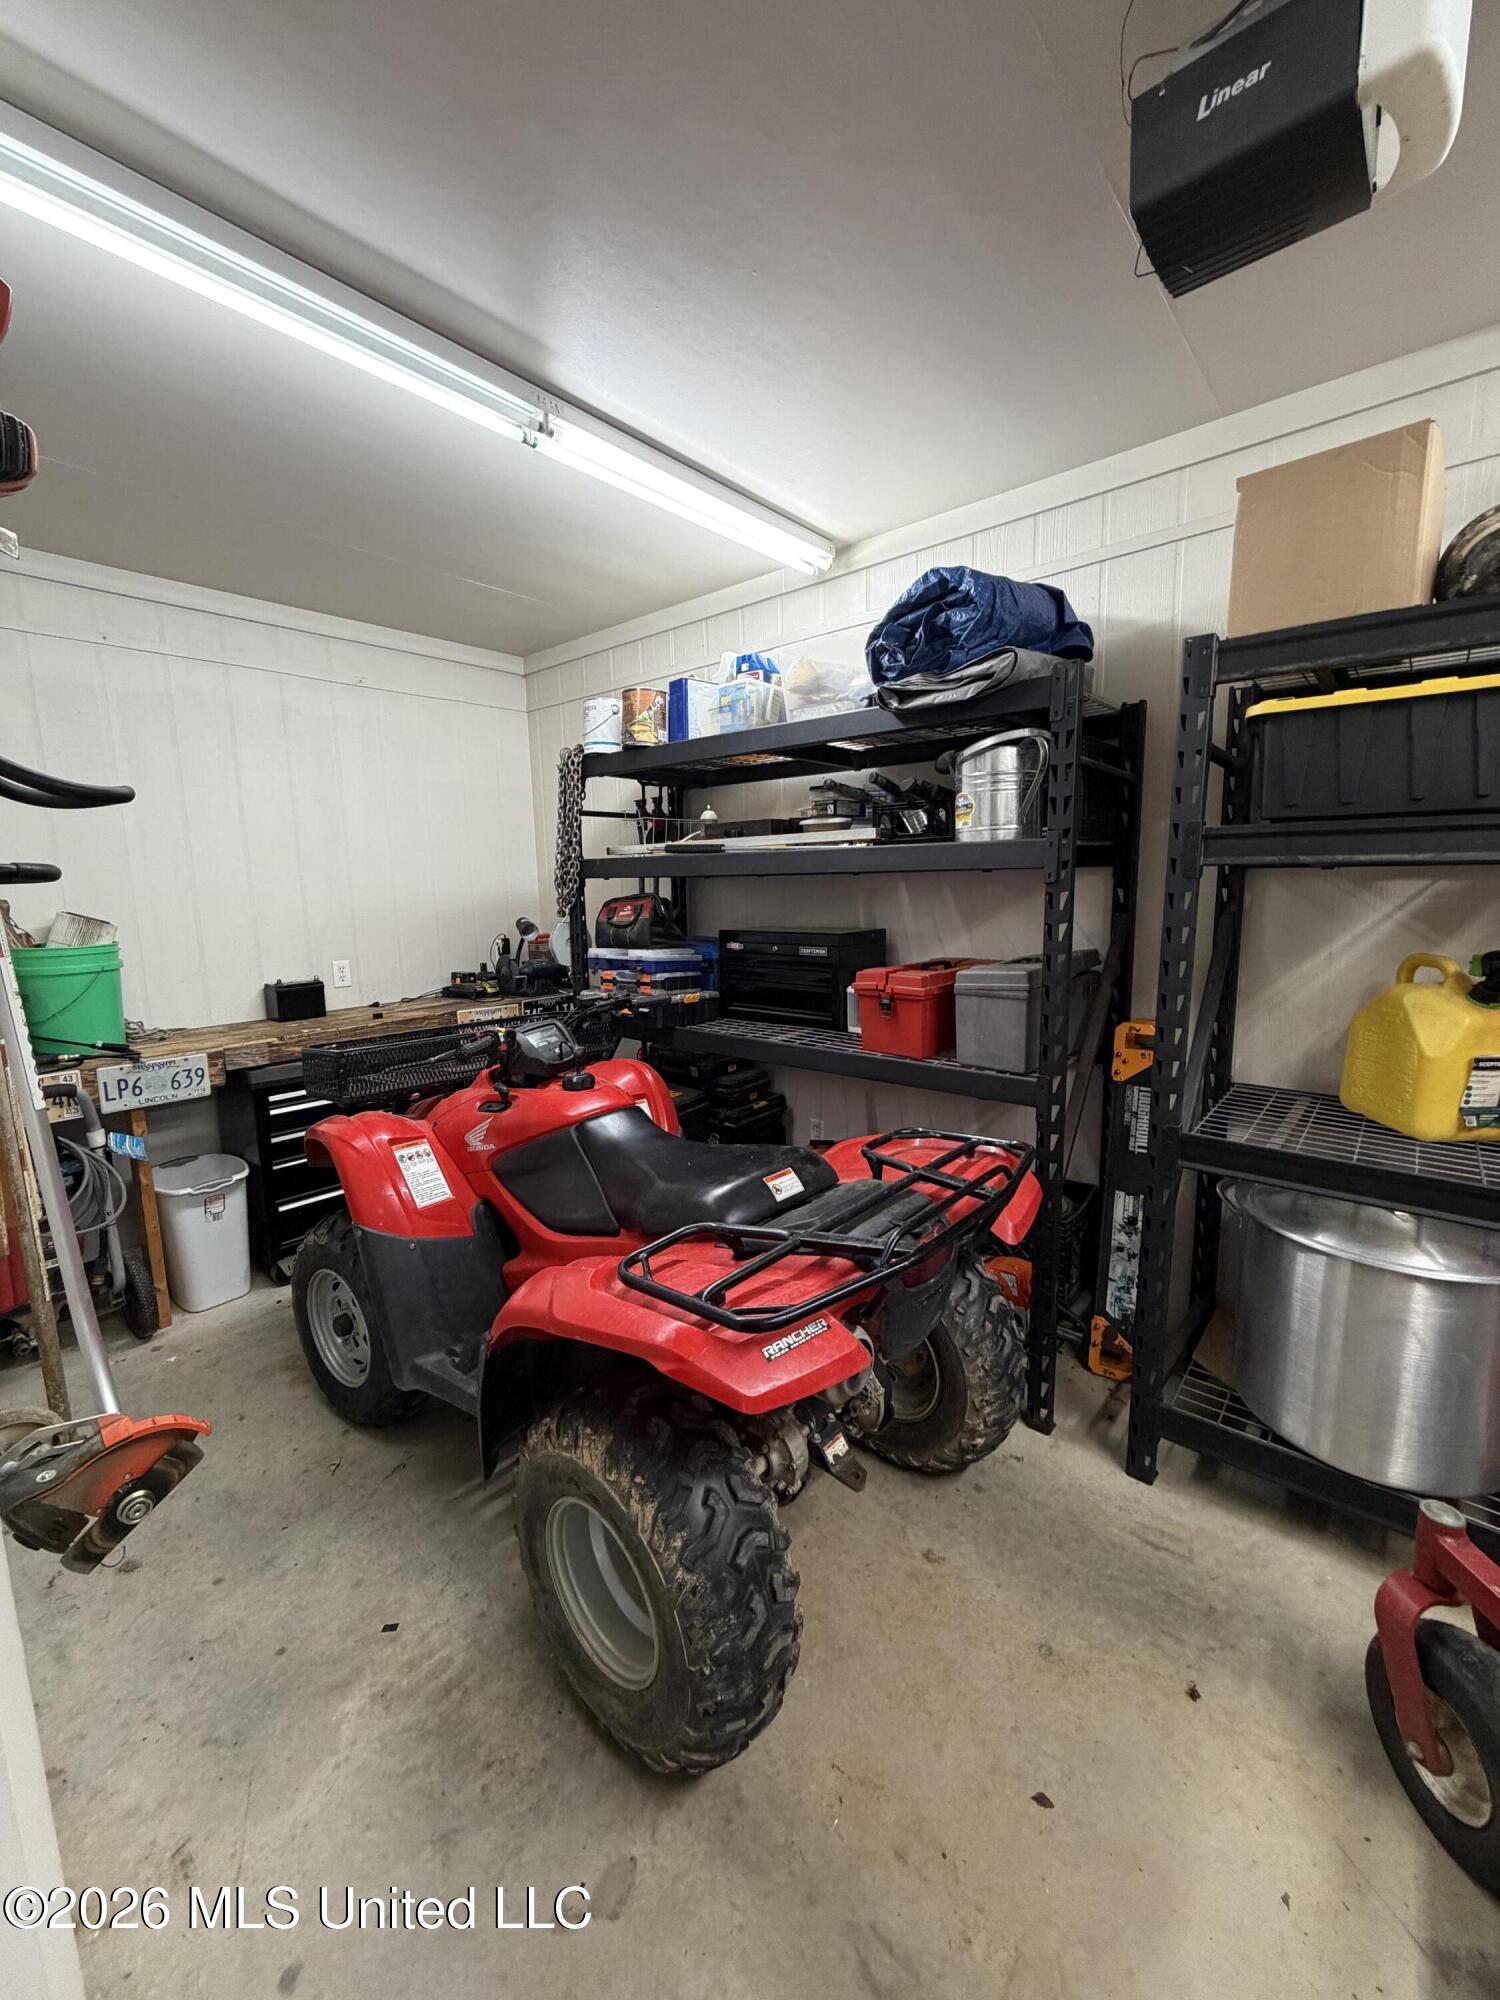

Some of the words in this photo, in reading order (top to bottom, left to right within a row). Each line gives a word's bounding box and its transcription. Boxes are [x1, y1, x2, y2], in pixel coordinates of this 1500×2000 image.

[1196, 60, 1272, 122] Linear
[103, 1077, 143, 1102] LP6
[171, 1067, 205, 1090] 639
[138, 1093, 178, 1105] LINCOLN
[467, 1143, 496, 1153] HONDA
[761, 1317, 828, 1359] RANCHER
